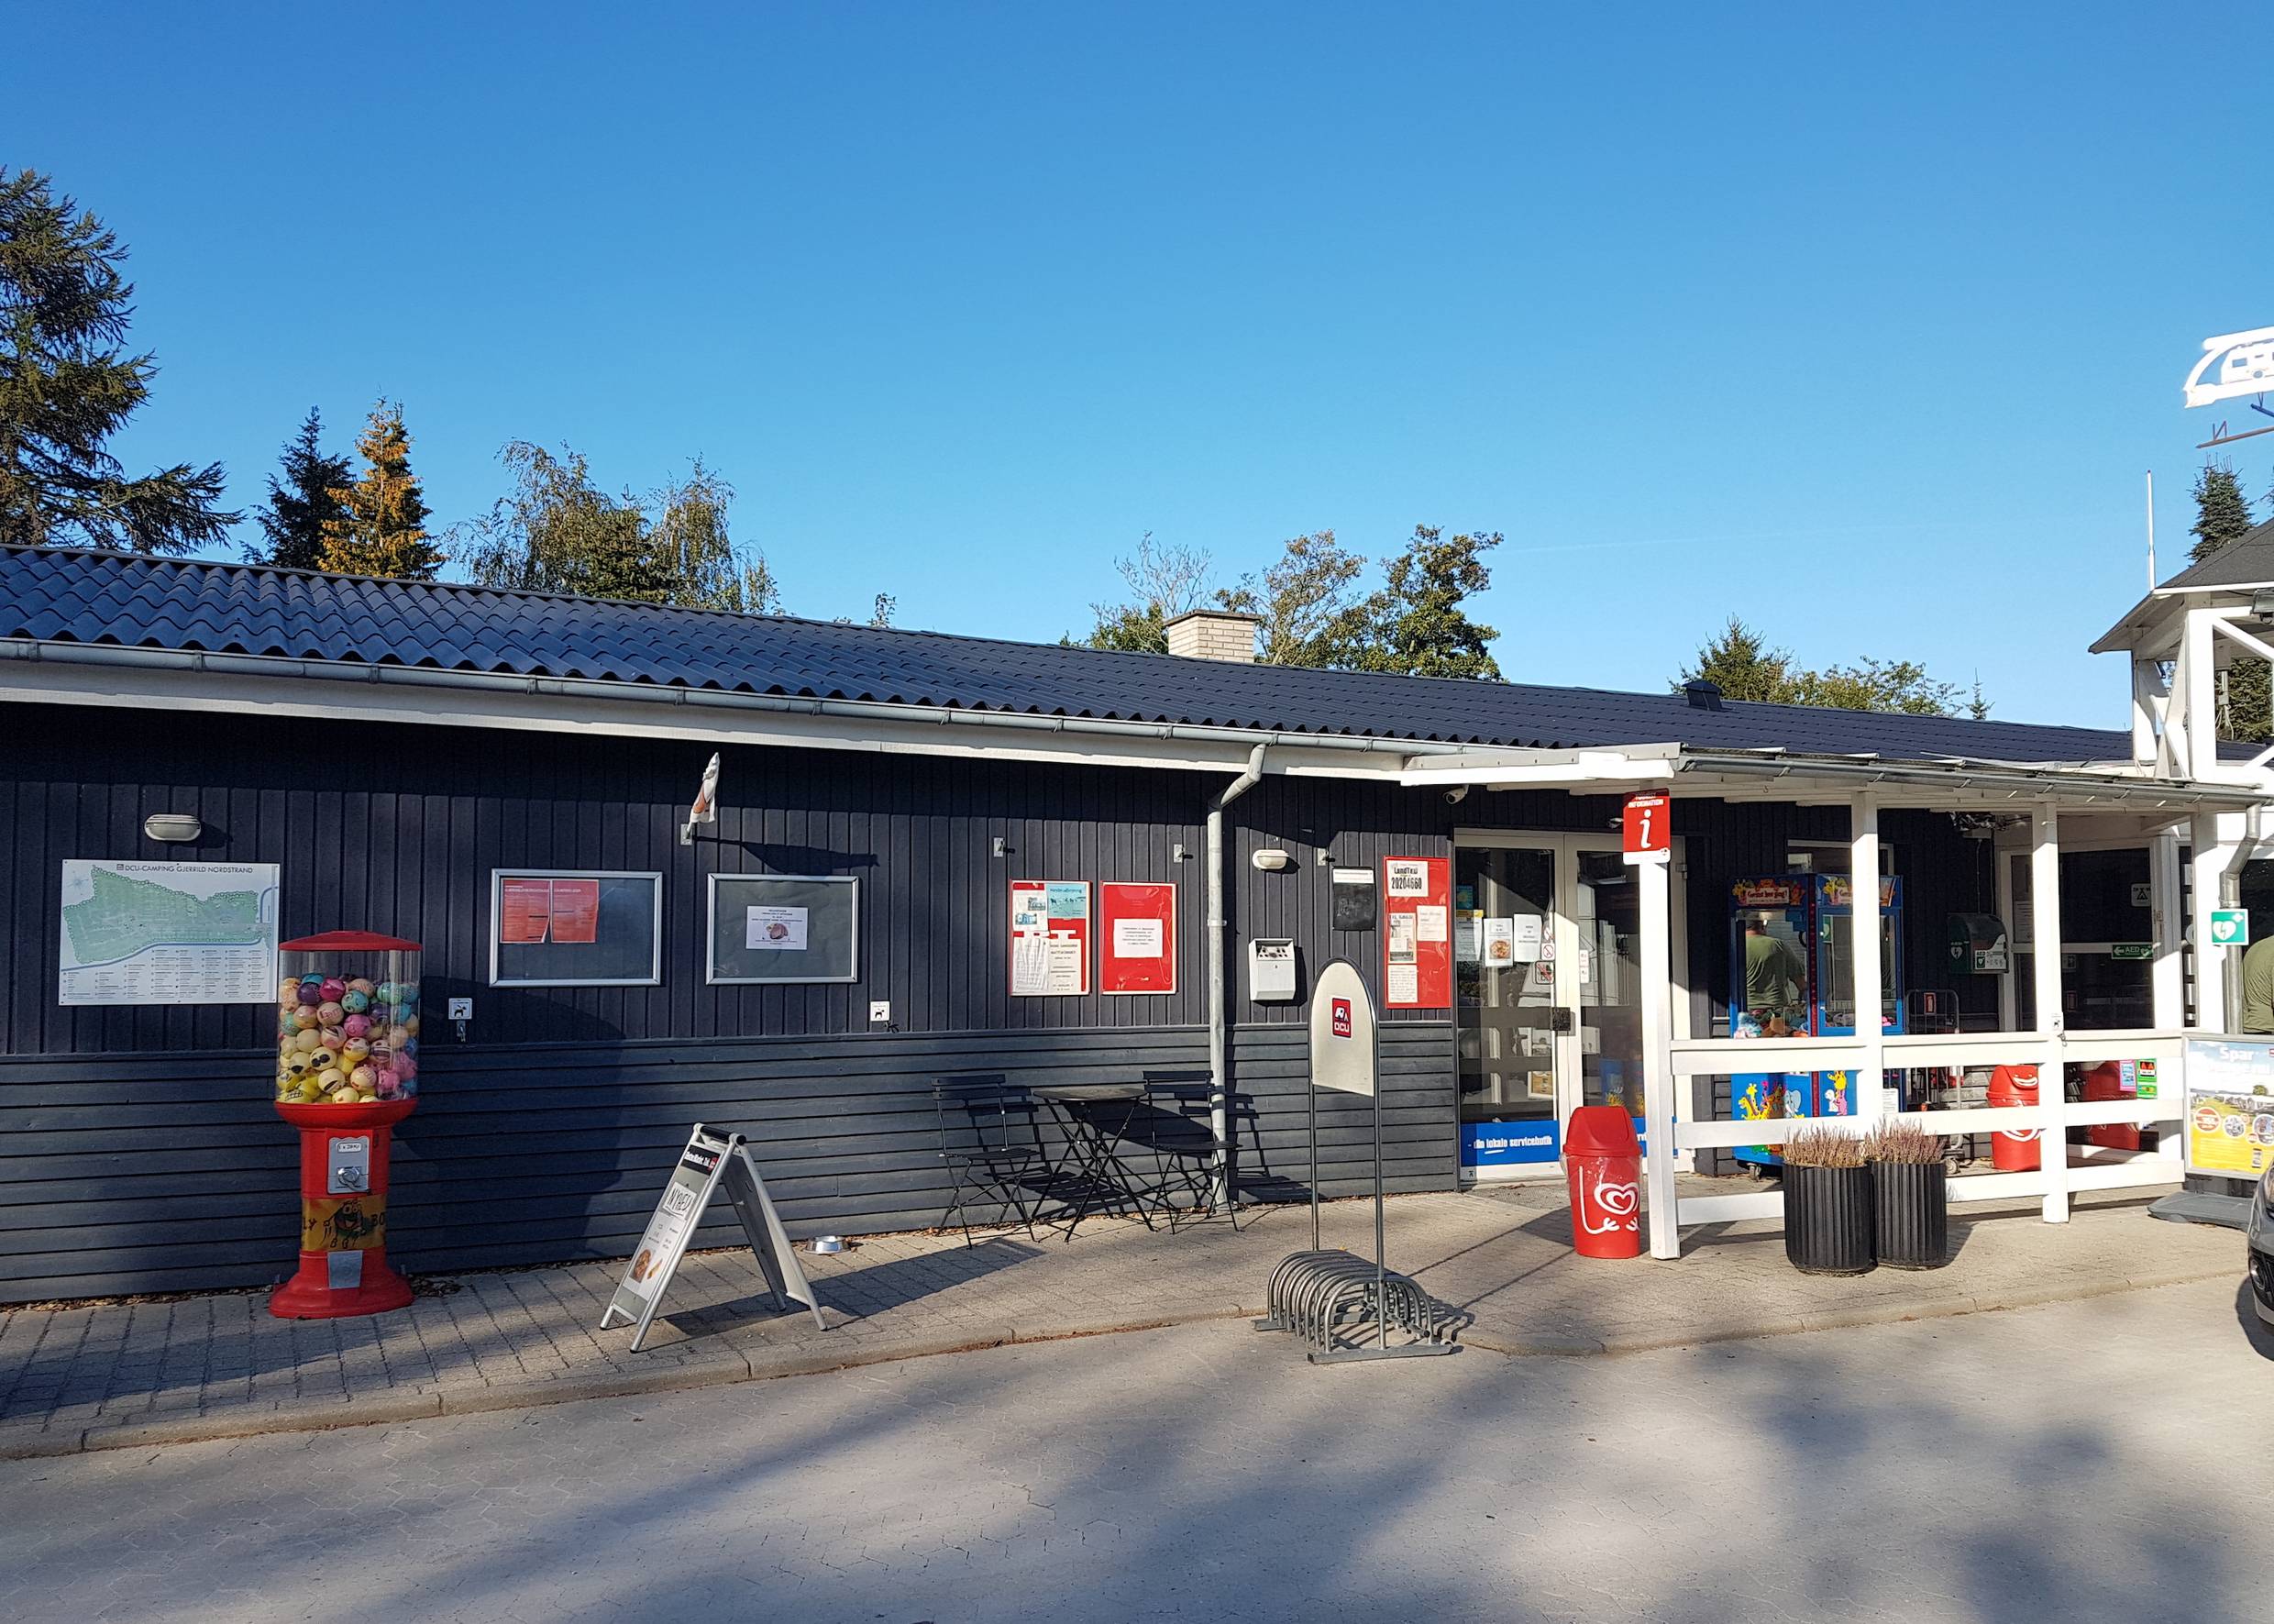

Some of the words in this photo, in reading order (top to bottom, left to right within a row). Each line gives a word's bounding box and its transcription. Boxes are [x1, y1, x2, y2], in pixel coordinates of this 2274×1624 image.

[1334, 1022, 1350, 1033] DCU
[2220, 1046, 2254, 1063] Spar
[1485, 1137, 1508, 1149] lokale
[1509, 1135, 1553, 1147] servicebutik
